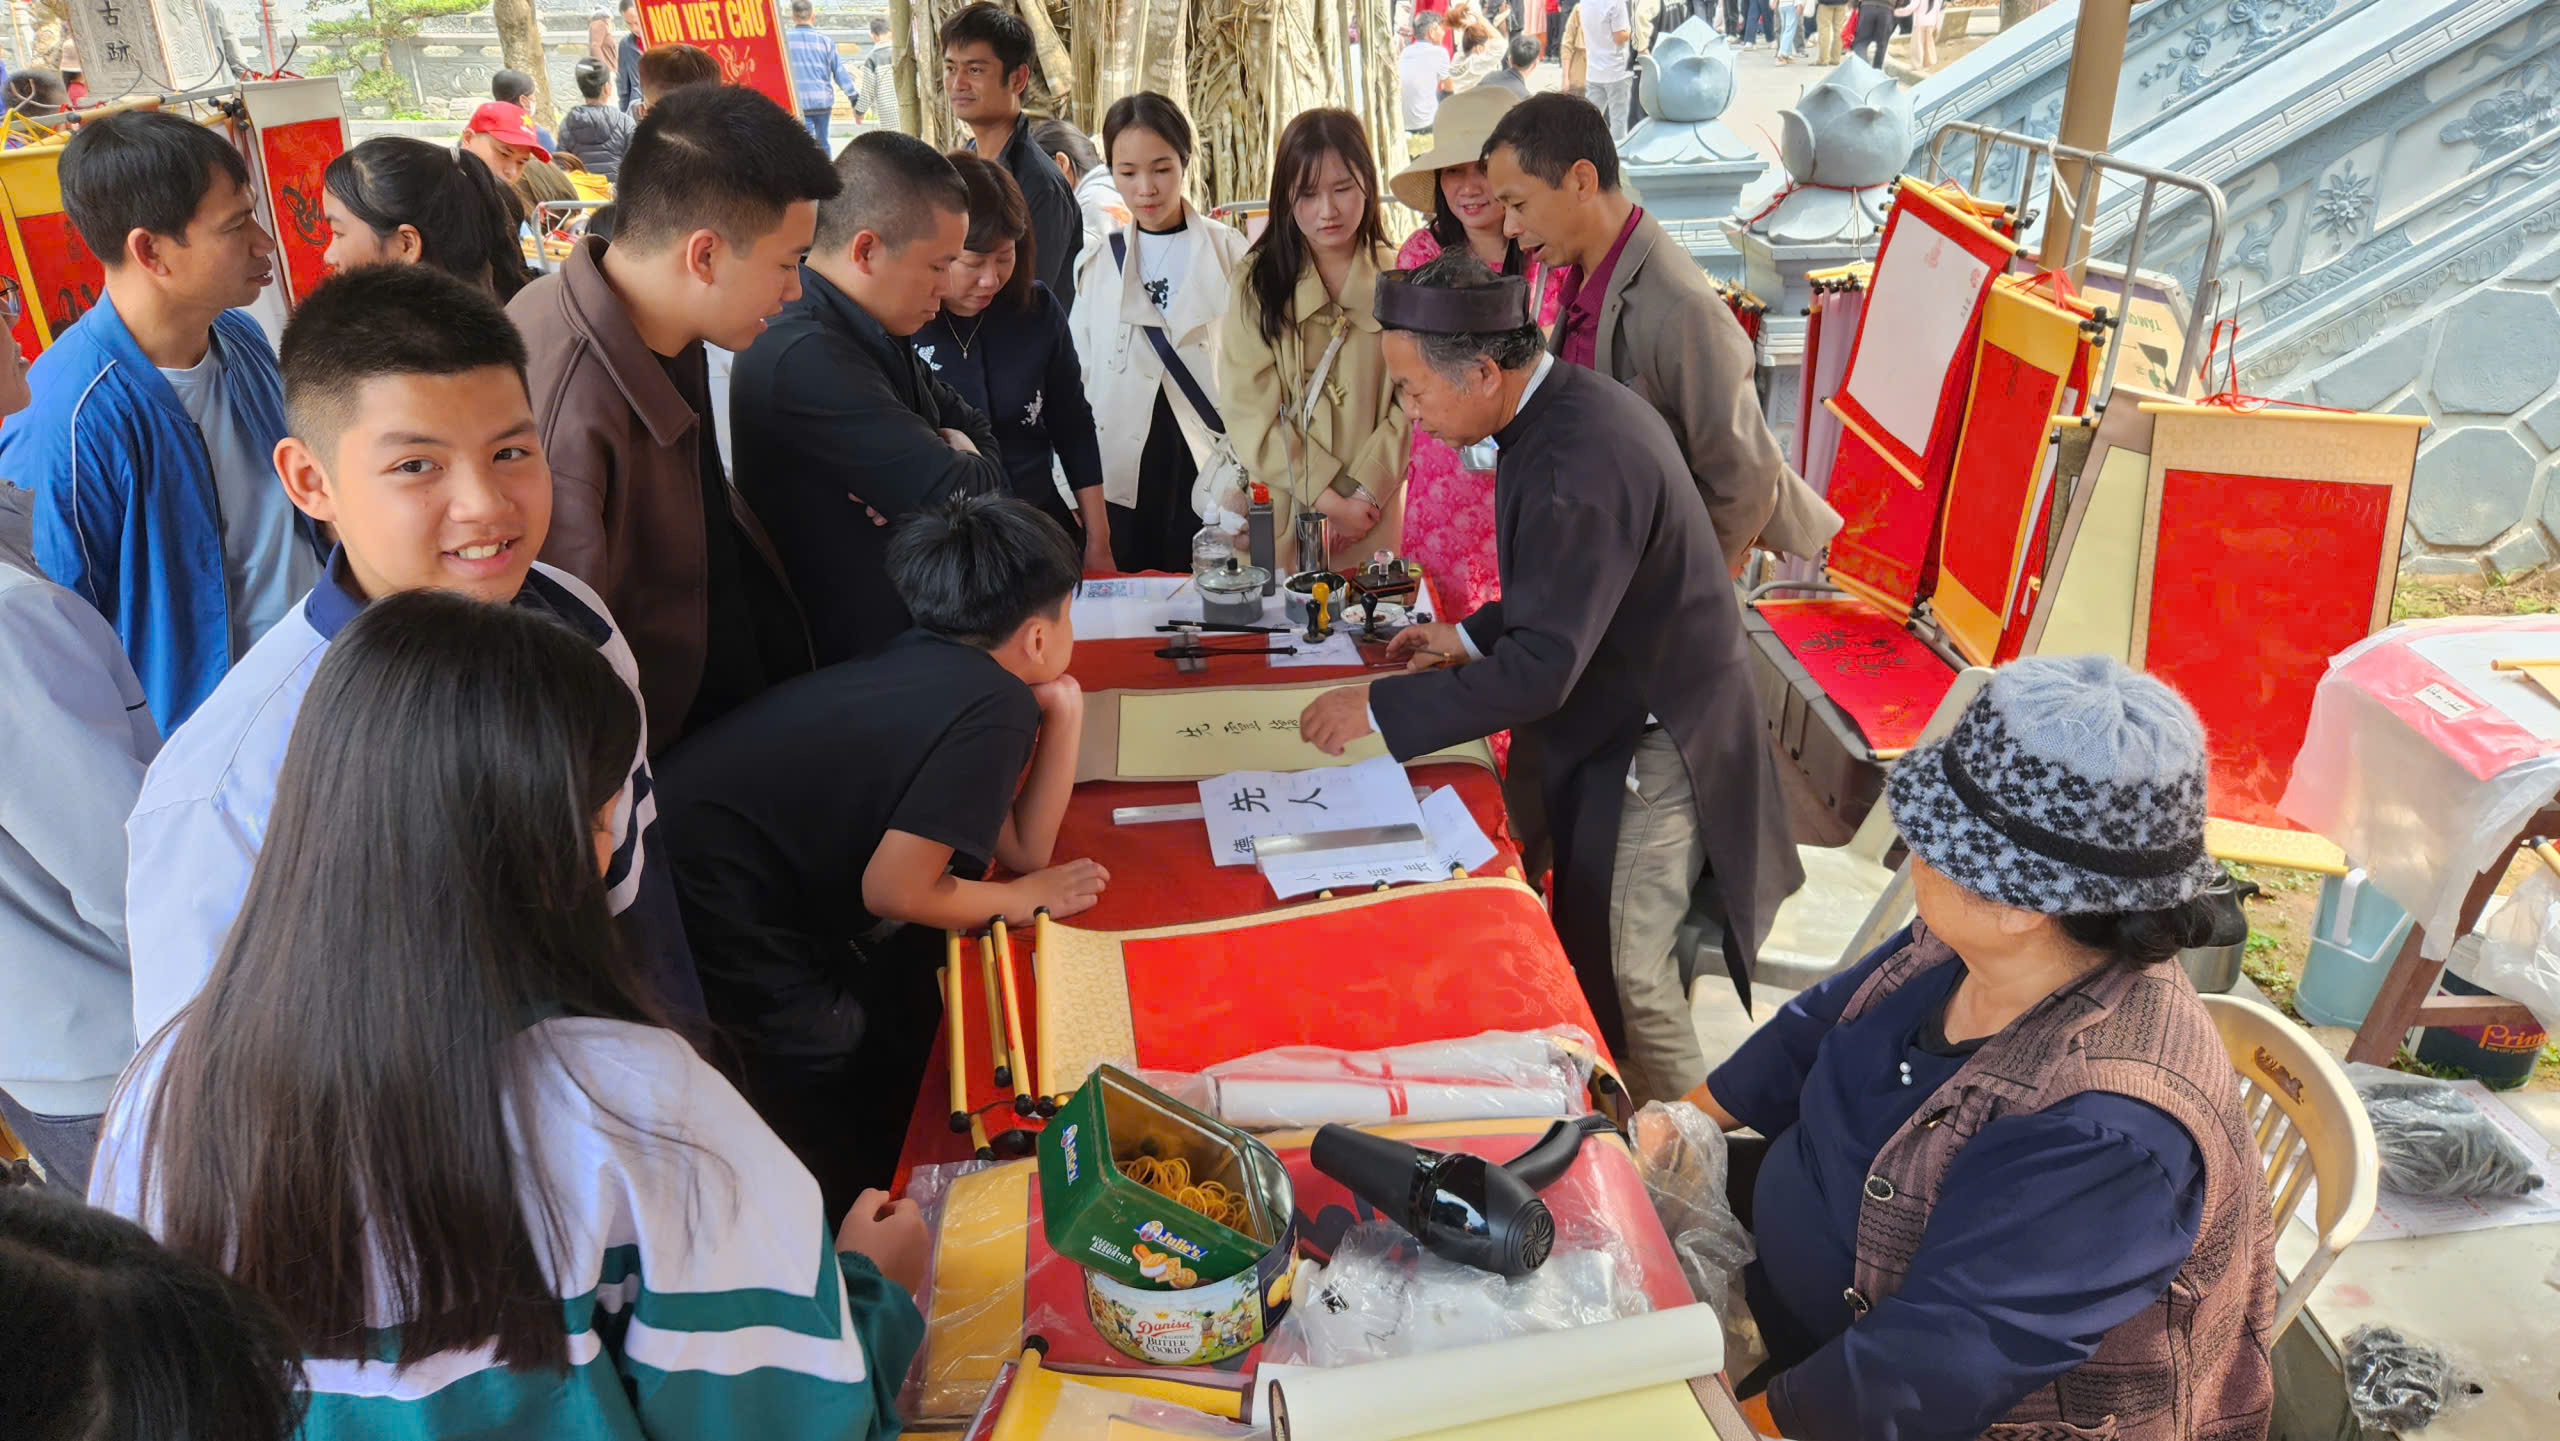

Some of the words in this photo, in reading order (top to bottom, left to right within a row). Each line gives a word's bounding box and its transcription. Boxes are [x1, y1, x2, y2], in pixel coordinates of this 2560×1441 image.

[647, 2, 684, 43] NƠI
[1158, 1231, 1201, 1257] Julie's
[1136, 1319, 1191, 1335] Danisa
[1146, 1344, 1190, 1354] COOKIES
[1147, 1336, 1186, 1347] BUTTER
